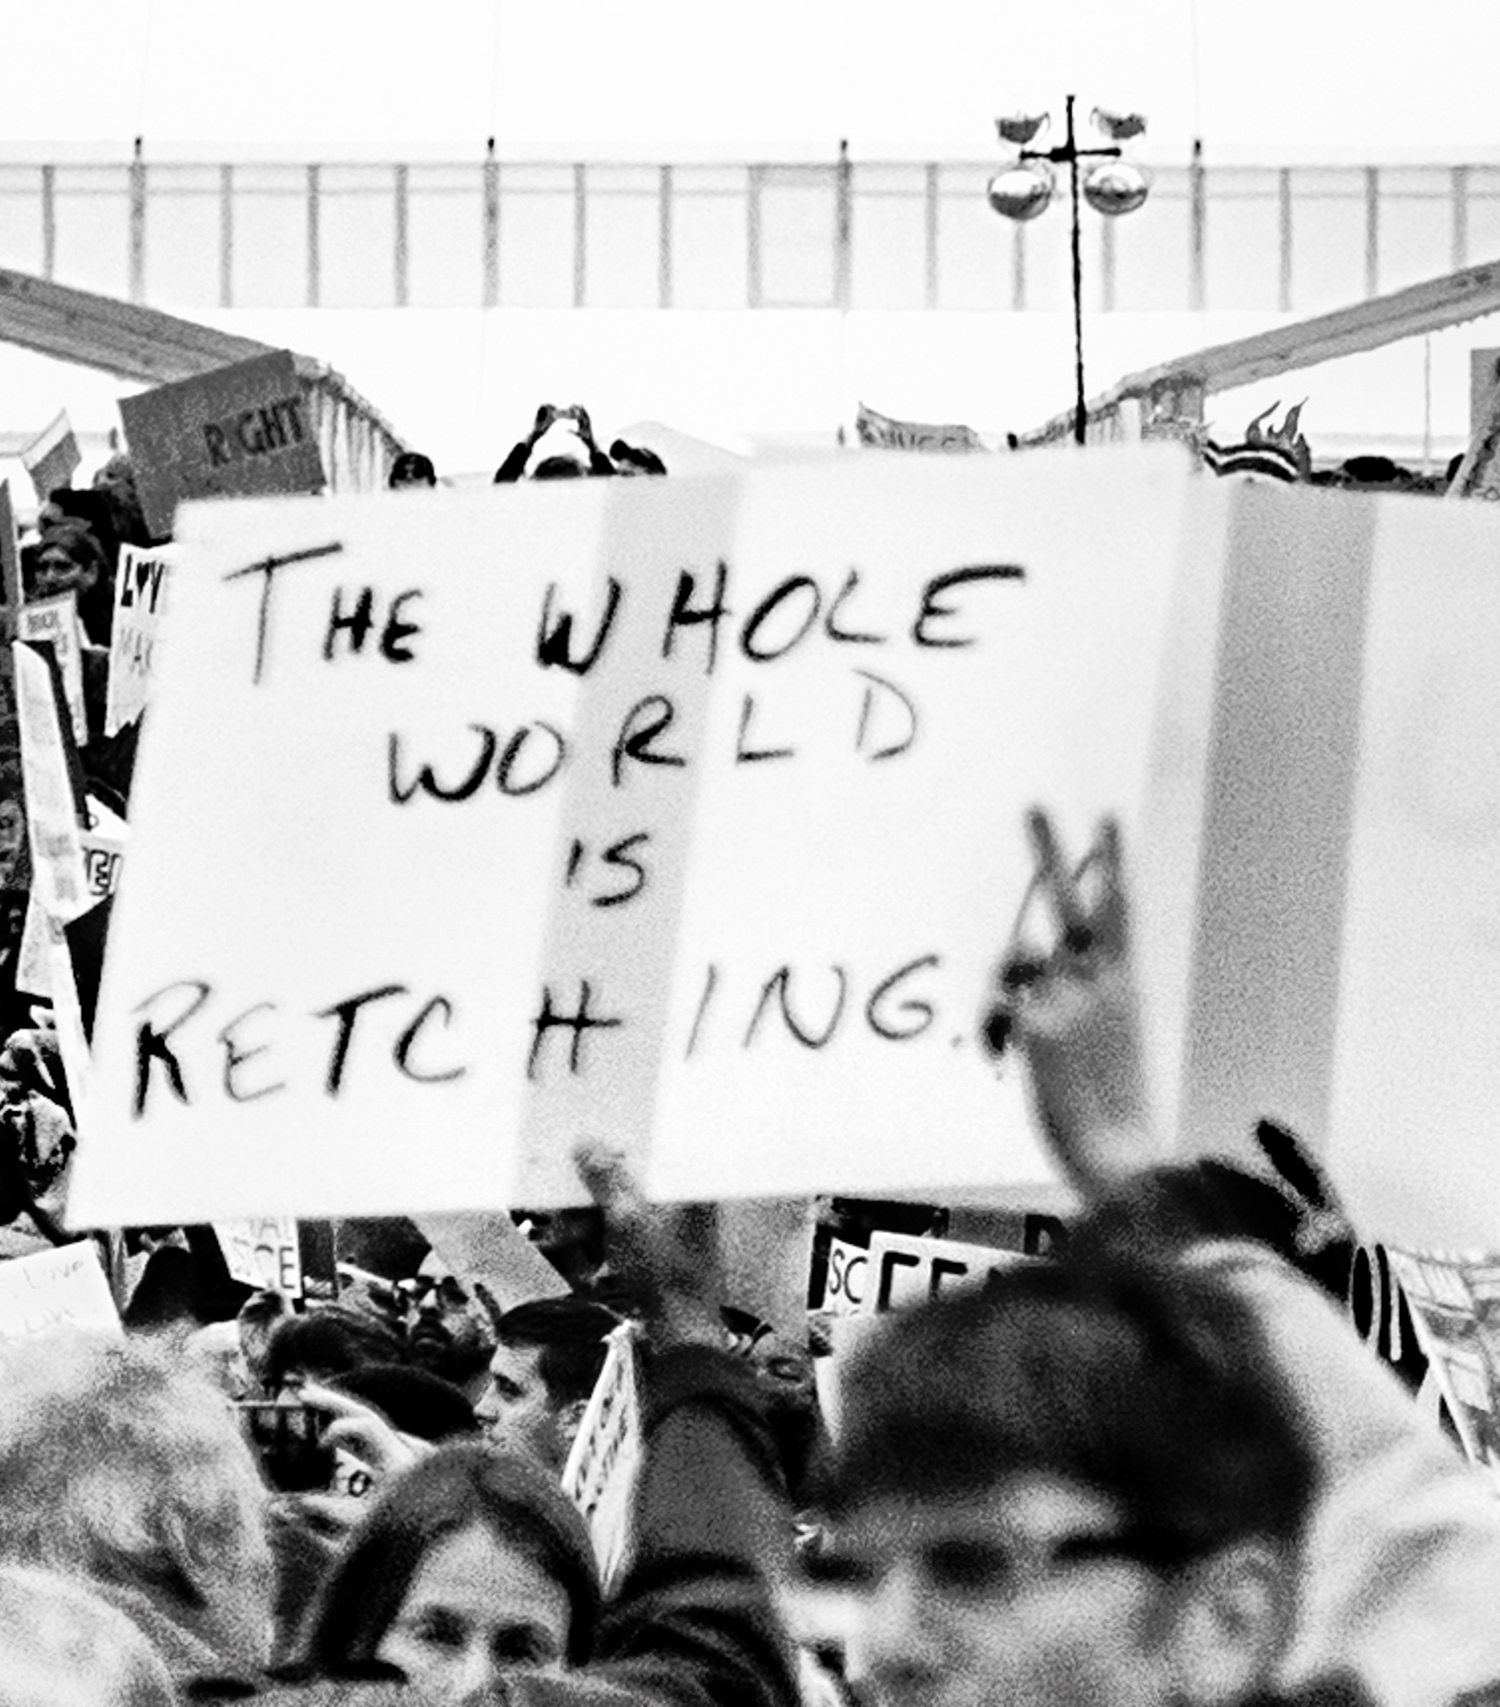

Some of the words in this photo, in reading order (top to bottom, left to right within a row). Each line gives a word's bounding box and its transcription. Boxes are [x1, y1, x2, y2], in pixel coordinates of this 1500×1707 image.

[222, 541, 424, 685] THE
[536, 558, 1027, 677] WHOLE
[388, 668, 919, 805] WORLD
[564, 833, 651, 908] IS
